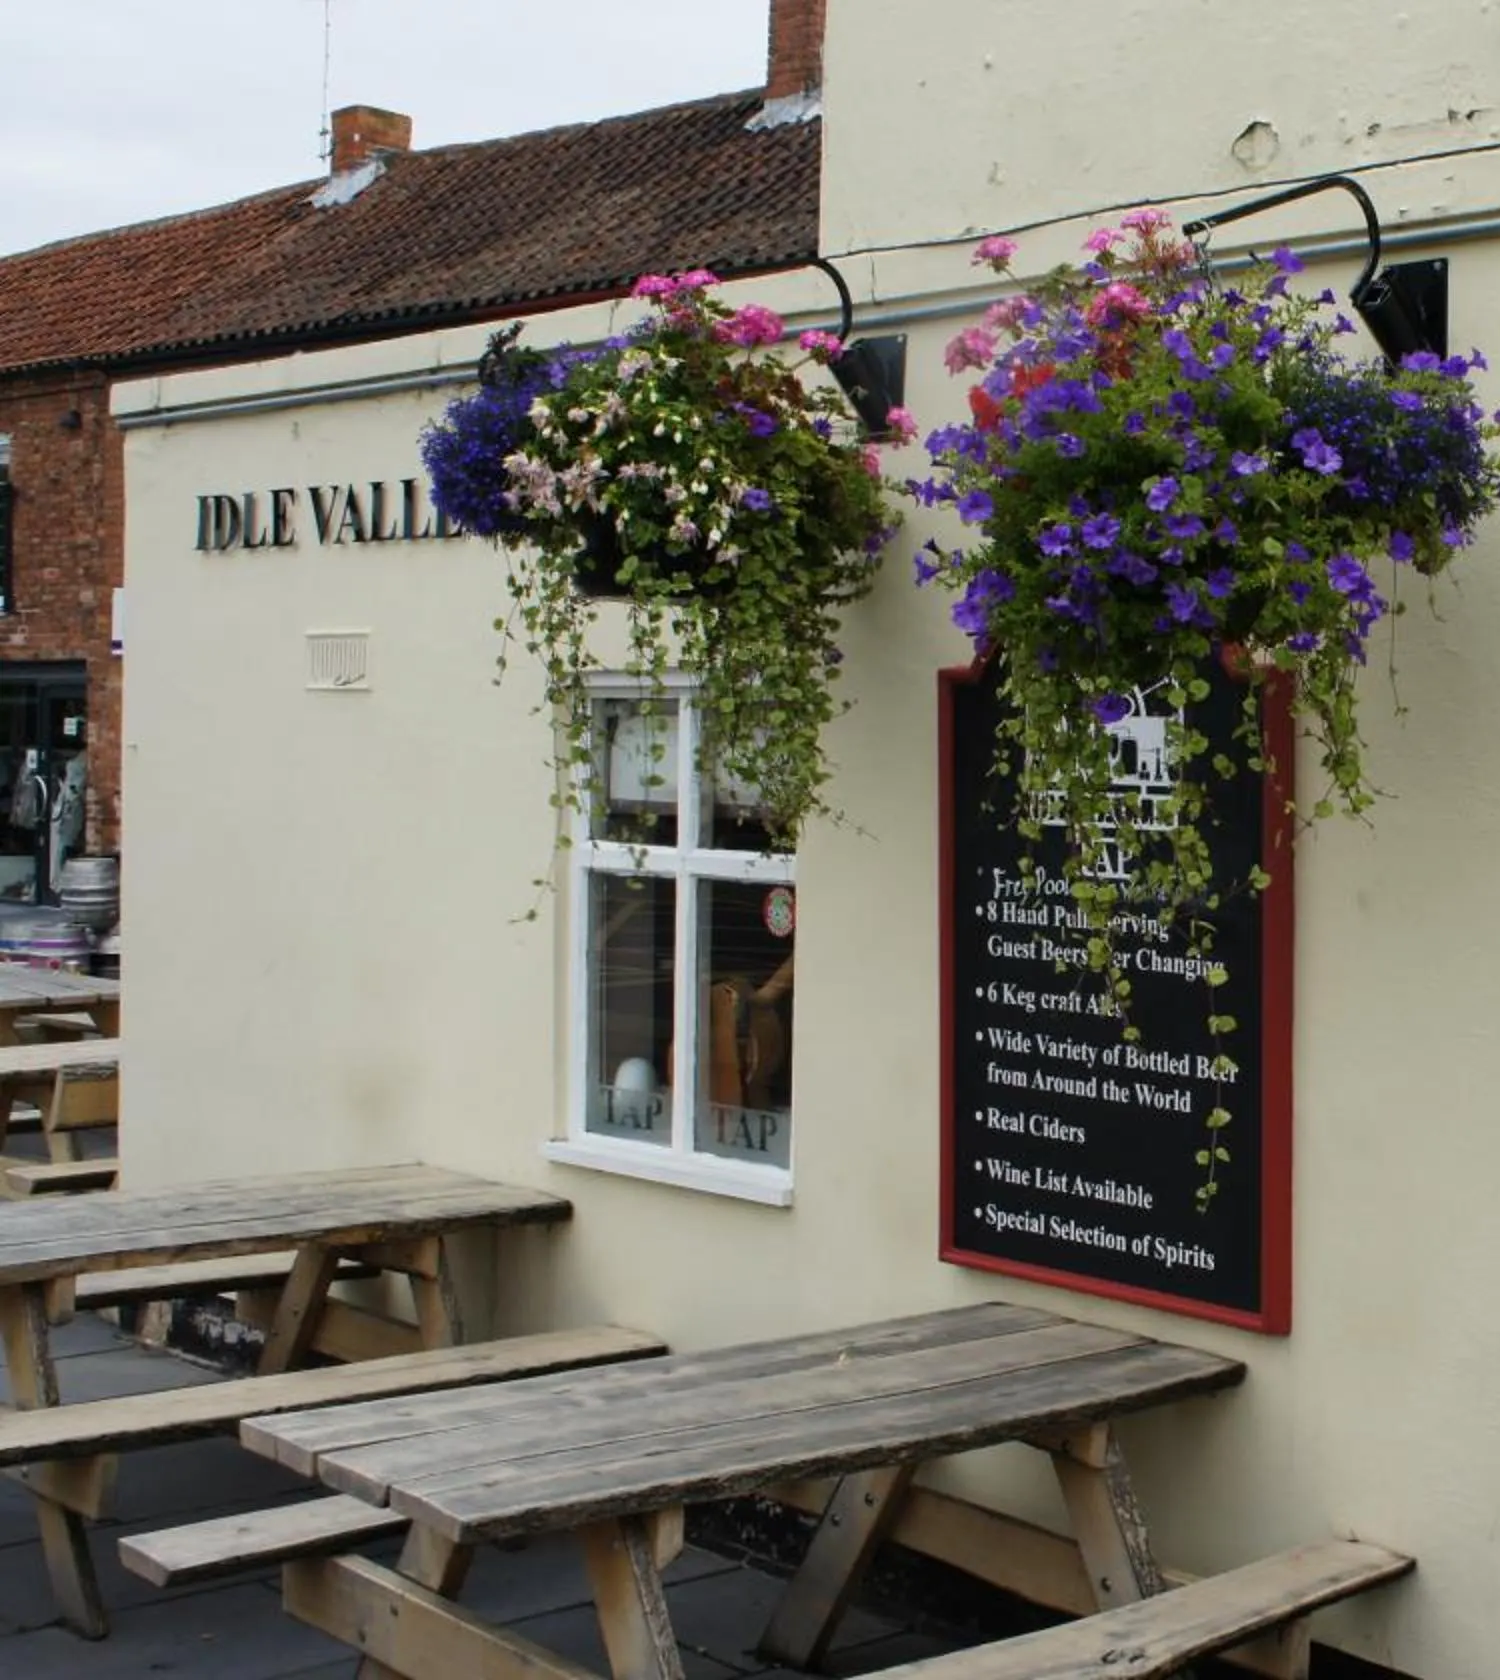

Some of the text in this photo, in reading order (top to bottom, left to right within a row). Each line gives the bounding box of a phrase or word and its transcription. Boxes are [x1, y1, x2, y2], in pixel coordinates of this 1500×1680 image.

[195, 487, 296, 552] IDLE
[986, 900, 1169, 943] 8 Hand Pull erving
[987, 935, 1036, 960] Guest
[1041, 939, 1089, 966] Beers
[987, 981, 997, 1003] 6
[1002, 983, 1036, 1013] Keg
[1041, 990, 1081, 1013] craft
[988, 1026, 1032, 1055] Wide
[1035, 1033, 1098, 1068] Variety
[1102, 1045, 1121, 1067] of
[1125, 1047, 1190, 1076] Bottled
[987, 1061, 1192, 1114] from Around the World
[711, 1103, 778, 1151] TAP
[987, 1107, 1086, 1144] Real Ciders
[987, 1158, 1153, 1210] Wine List Available
[985, 1204, 1215, 1271] Special Selection of Spirits
